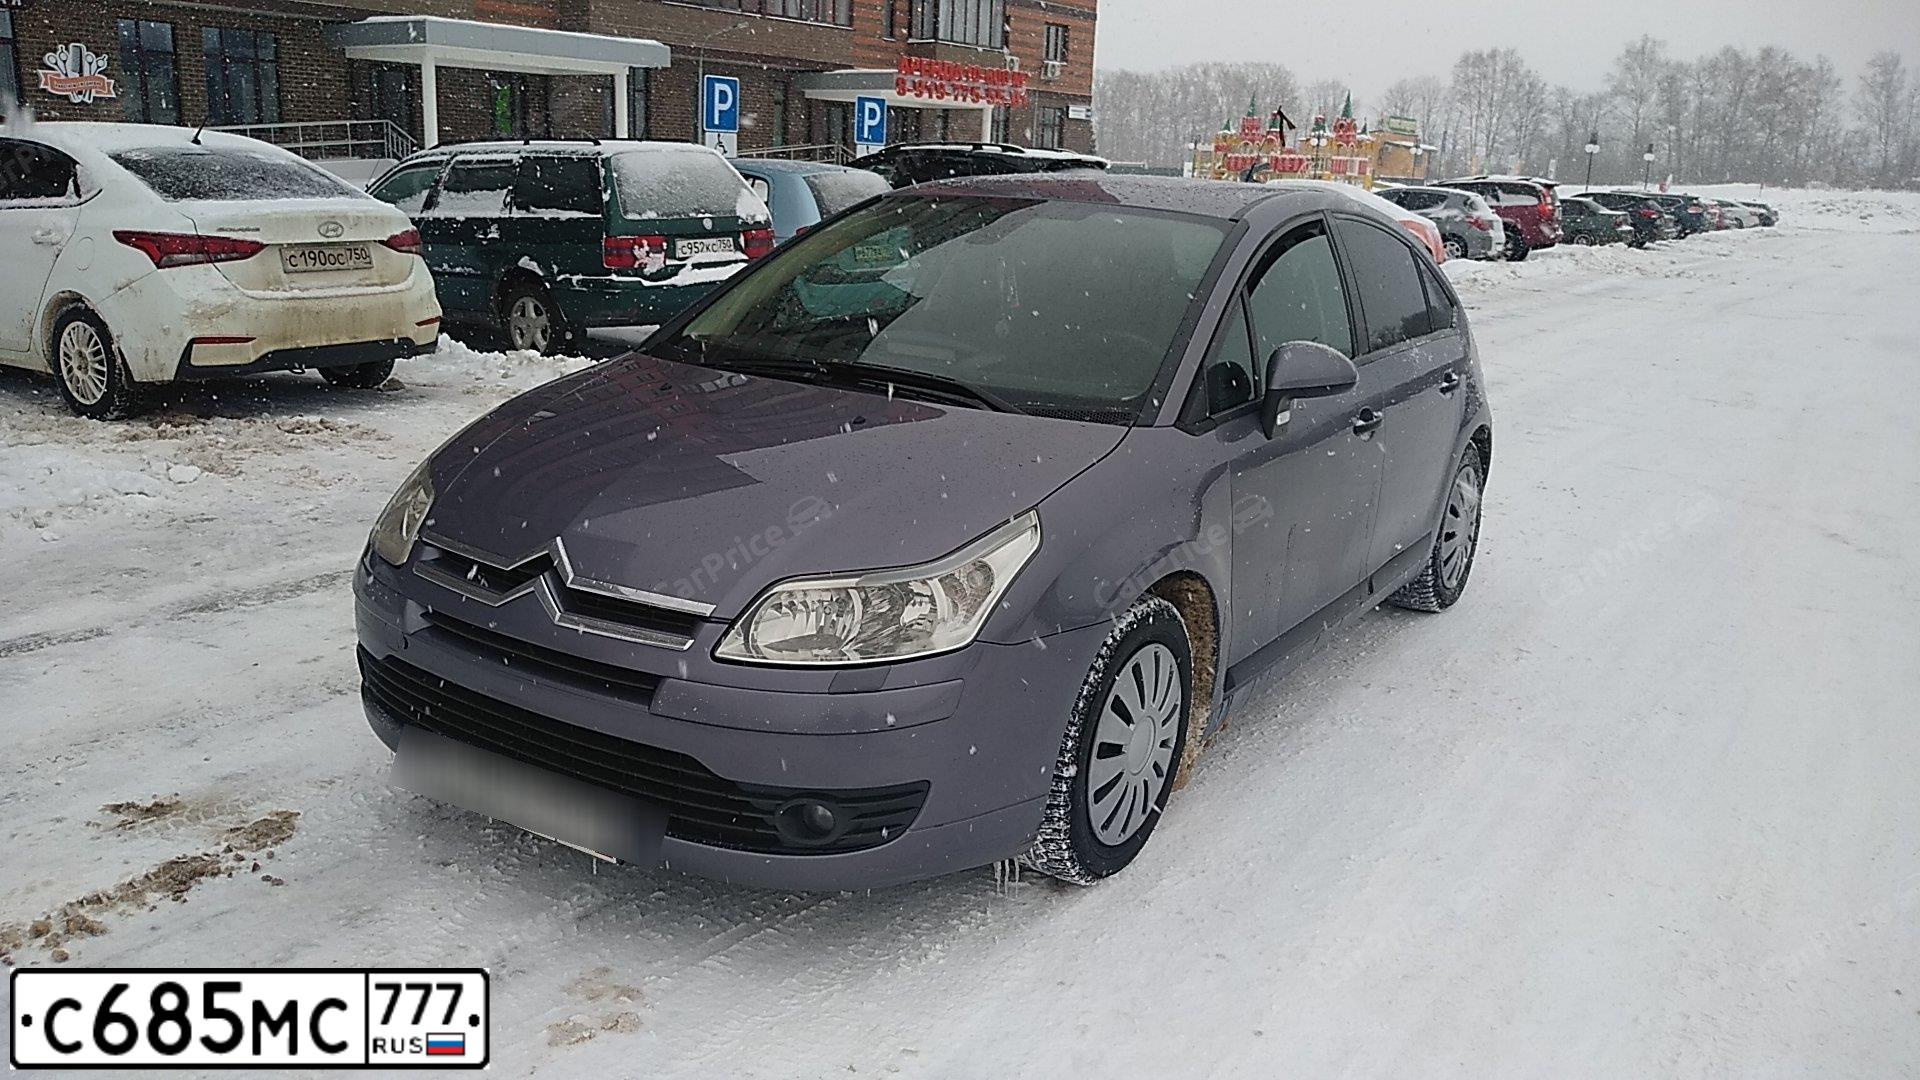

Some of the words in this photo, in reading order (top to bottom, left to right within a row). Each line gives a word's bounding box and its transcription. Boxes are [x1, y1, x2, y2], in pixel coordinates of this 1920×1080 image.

[713, 82, 733, 125] P
[863, 101, 881, 139] P
[346, 248, 368, 260] 750
